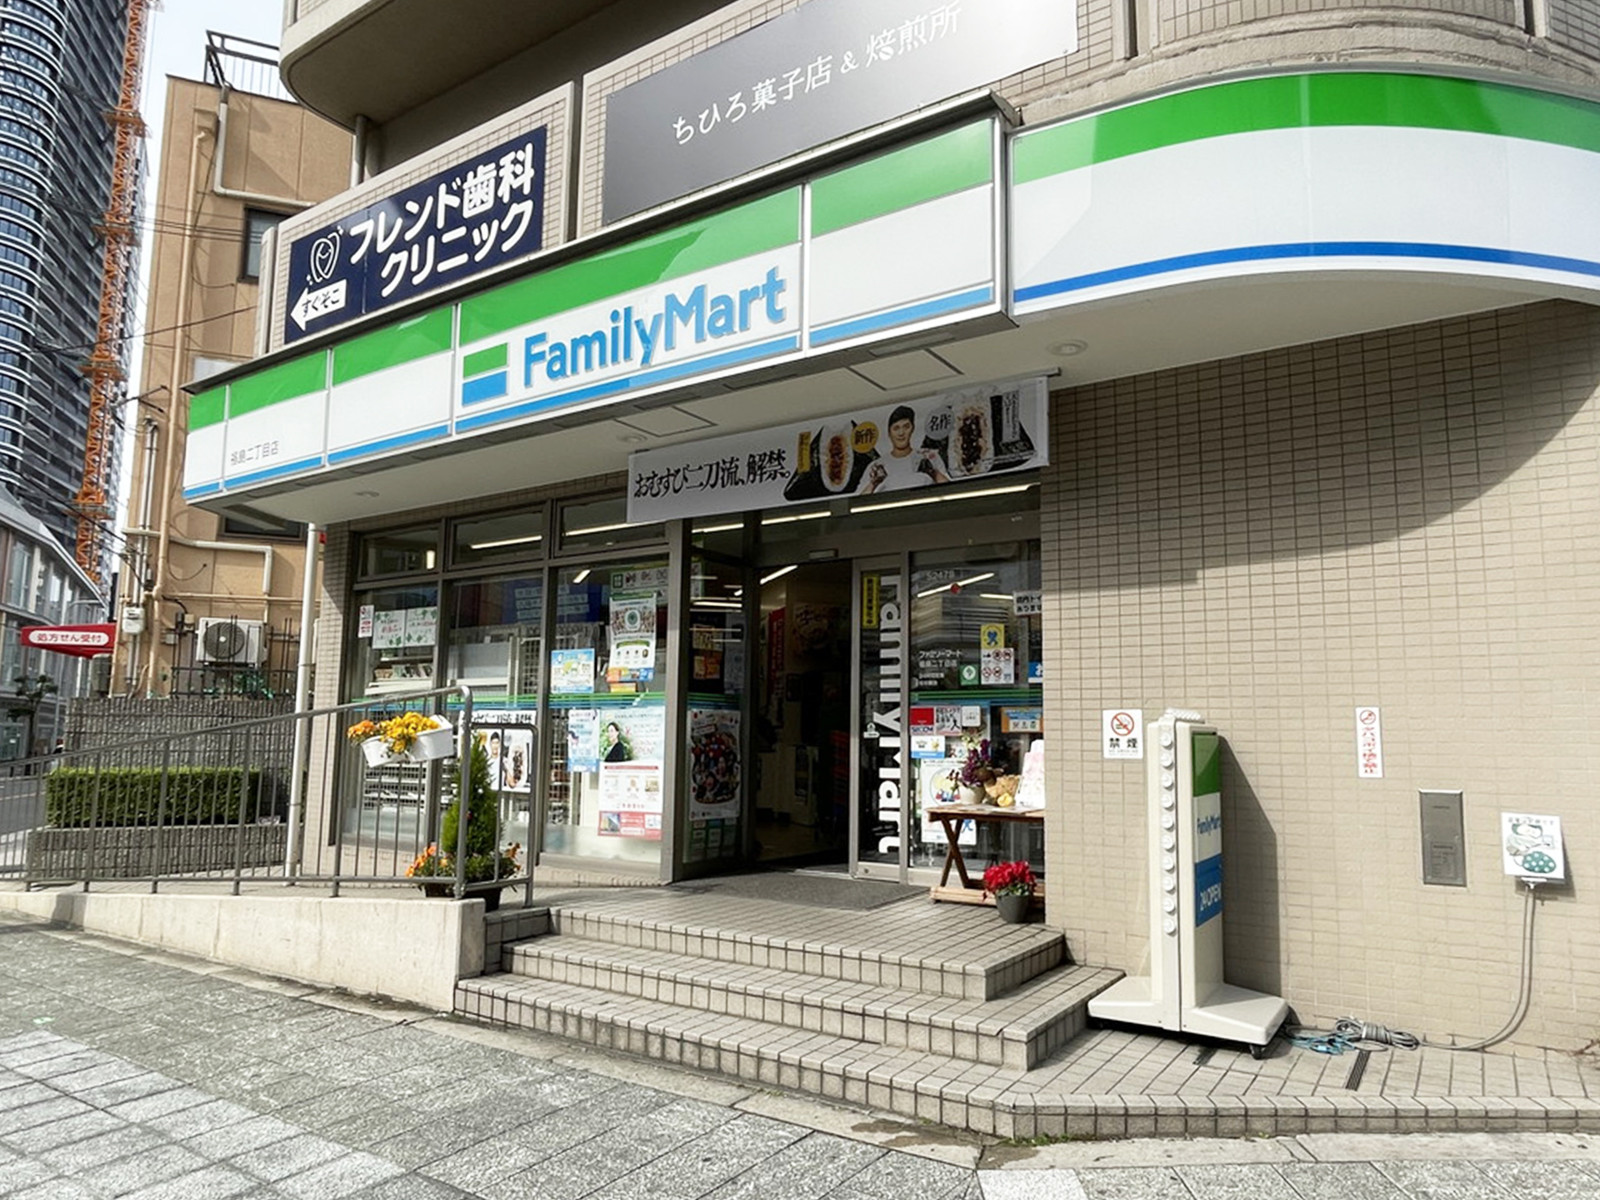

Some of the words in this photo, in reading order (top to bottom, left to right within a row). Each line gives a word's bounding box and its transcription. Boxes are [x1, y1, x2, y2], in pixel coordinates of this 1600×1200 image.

[672, 56, 833, 145] ちひろ菓子店
[840, 50, 859, 74] &
[864, 2, 962, 69] 焙煎所
[350, 143, 535, 264] フレンド歯科
[381, 200, 534, 298] クリニック
[301, 287, 341, 317] すぐそこ
[523, 266, 787, 389] FamilyMart
[633, 447, 791, 498] おむすび二刀流、解禁。
[36, 632, 102, 643] 処方せん受付
